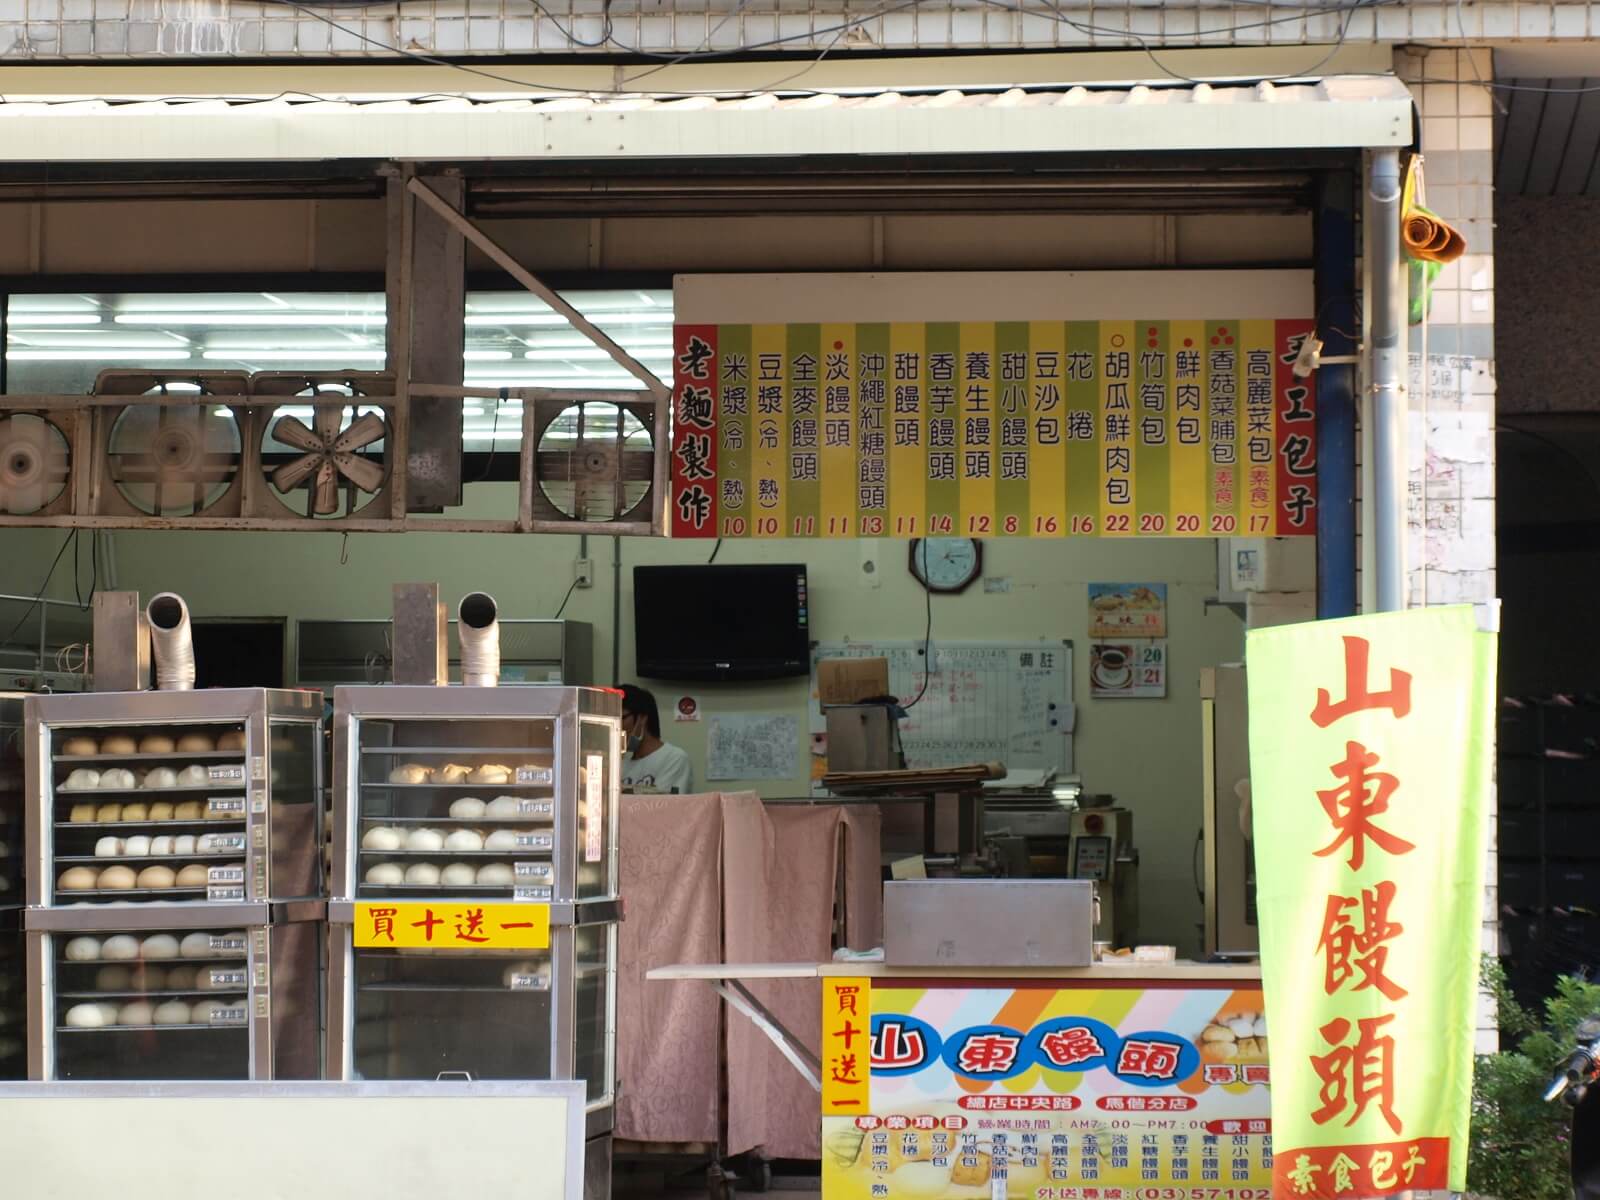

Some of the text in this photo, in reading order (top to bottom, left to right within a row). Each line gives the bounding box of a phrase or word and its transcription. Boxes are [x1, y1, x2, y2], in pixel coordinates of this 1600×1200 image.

[825, 354, 851, 447] 淡饅頭
[894, 353, 919, 447] 甜饅頭
[1035, 352, 1060, 444] 豆沙包
[1068, 352, 1093, 440] 花捲
[1141, 352, 1166, 445] 竹筍包
[1176, 351, 1201, 444] 鮮肉包
[678, 335, 715, 529] 老麵製作
[792, 354, 817, 480] 全麥饅頭
[860, 354, 885, 509] 沖繩紅糖饅頭
[929, 353, 956, 480] 香芋饅頭
[964, 352, 991, 479] 養生饅頭
[1002, 353, 1027, 479] 甜小饅頭
[1105, 352, 1131, 505] 胡瓜鮮肉包
[723, 517, 745, 535] 10
[757, 517, 778, 535] 10
[794, 517, 813, 534] 11
[829, 517, 848, 534] 11
[861, 517, 882, 534] 13
[897, 517, 916, 533] 11
[929, 516, 951, 533] 14
[969, 516, 990, 533] 12
[1005, 516, 1017, 532] 8
[1036, 516, 1056, 532] 16
[1071, 516, 1092, 532] 16
[1106, 515, 1129, 532] 22
[1141, 515, 1164, 532] 20
[1176, 515, 1200, 532] 20
[1212, 515, 1236, 532] 20
[1249, 515, 1269, 531] 17
[1144, 648, 1161, 662] 20
[1144, 668, 1160, 683] 21
[1309, 636, 1416, 1136] 山東饅頭
[368, 907, 534, 943] 買十送一
[831, 985, 861, 1107] 買十送一
[870, 1021, 1183, 1079] 山東饅頭
[932, 1133, 947, 1166] 豆沙包
[1022, 1133, 1038, 1166] 鮮肉包
[1287, 1146, 1426, 1194] 素食包子
